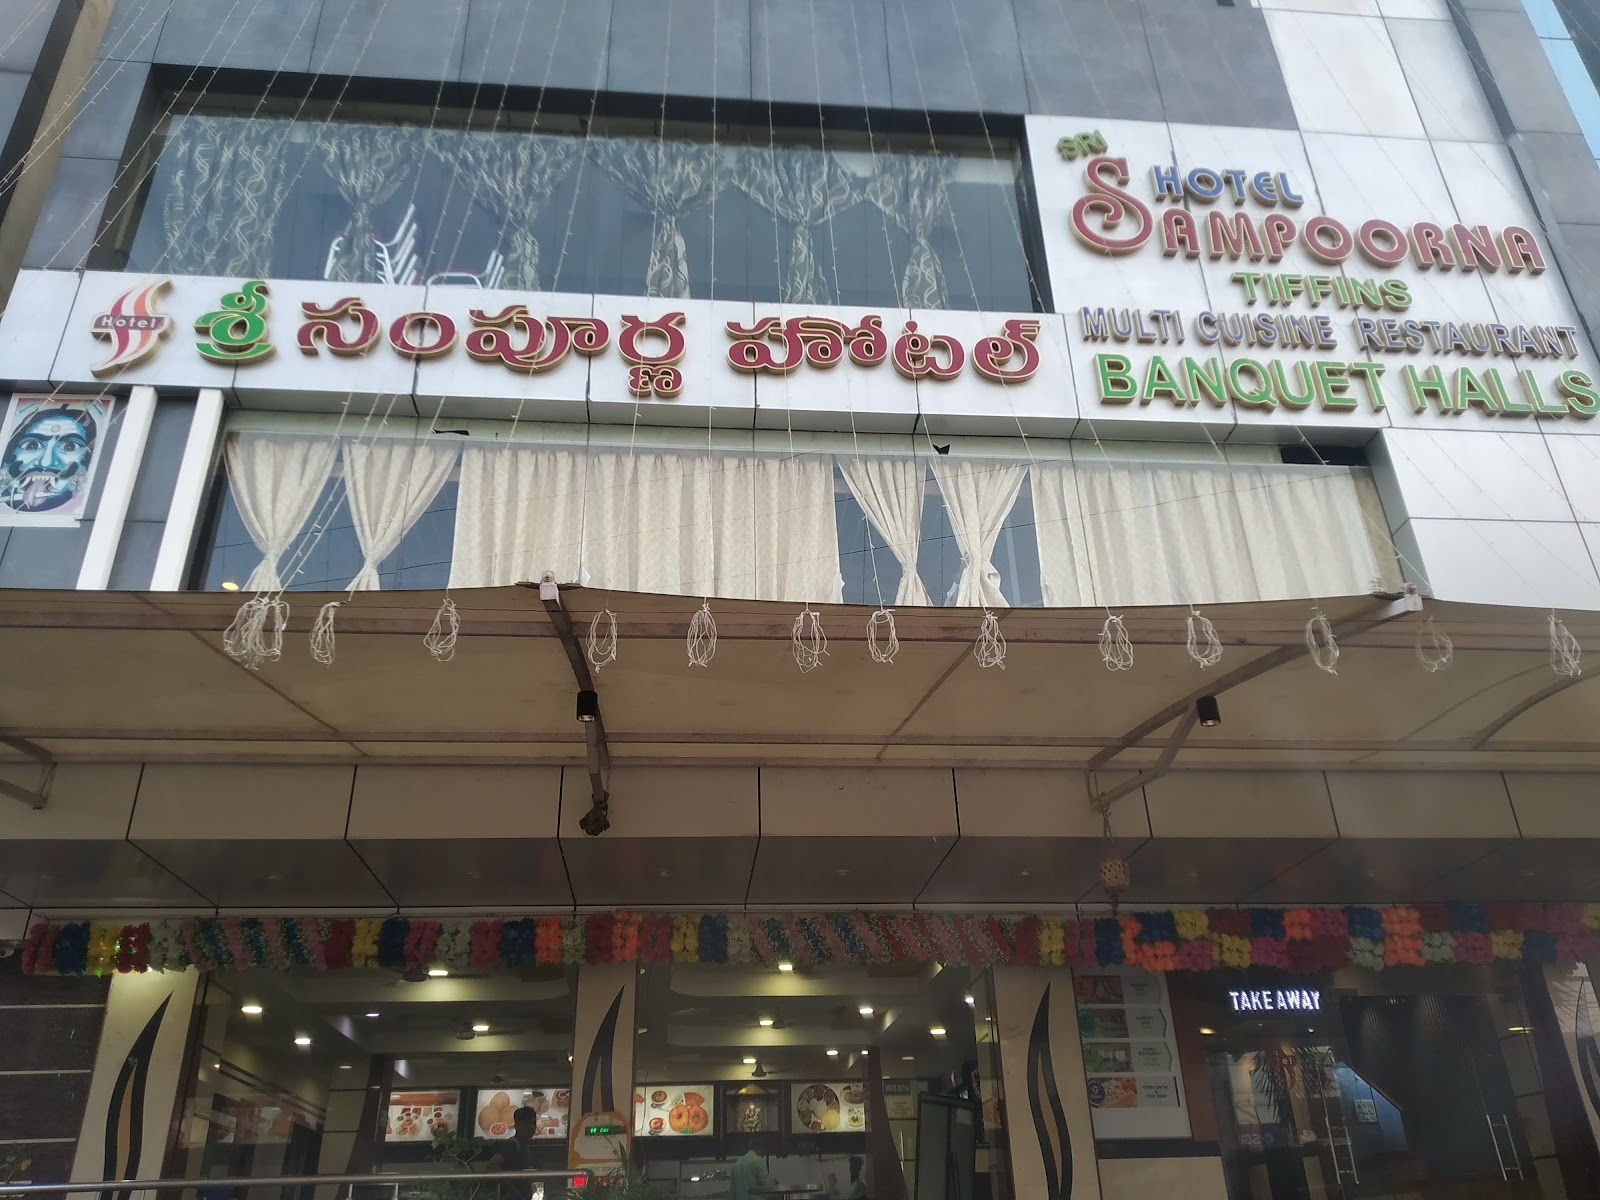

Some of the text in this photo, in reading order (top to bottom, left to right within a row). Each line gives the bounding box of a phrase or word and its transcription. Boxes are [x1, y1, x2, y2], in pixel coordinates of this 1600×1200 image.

[1056, 129, 1108, 160] SRI
[1152, 164, 1303, 208] HOTEL
[1070, 156, 1547, 276] SAMPOORNA
[1231, 271, 1413, 311] TIFFINS
[101, 316, 157, 328] Hotel
[194, 279, 1041, 398] శ్రీ సంపూర్ణ హోటల్
[1080, 306, 1580, 359] MULTI CUISINE RESTAURANT
[1094, 352, 1600, 420] BANQUET HALLS
[1228, 989, 1320, 1011] TAKE AWAY
